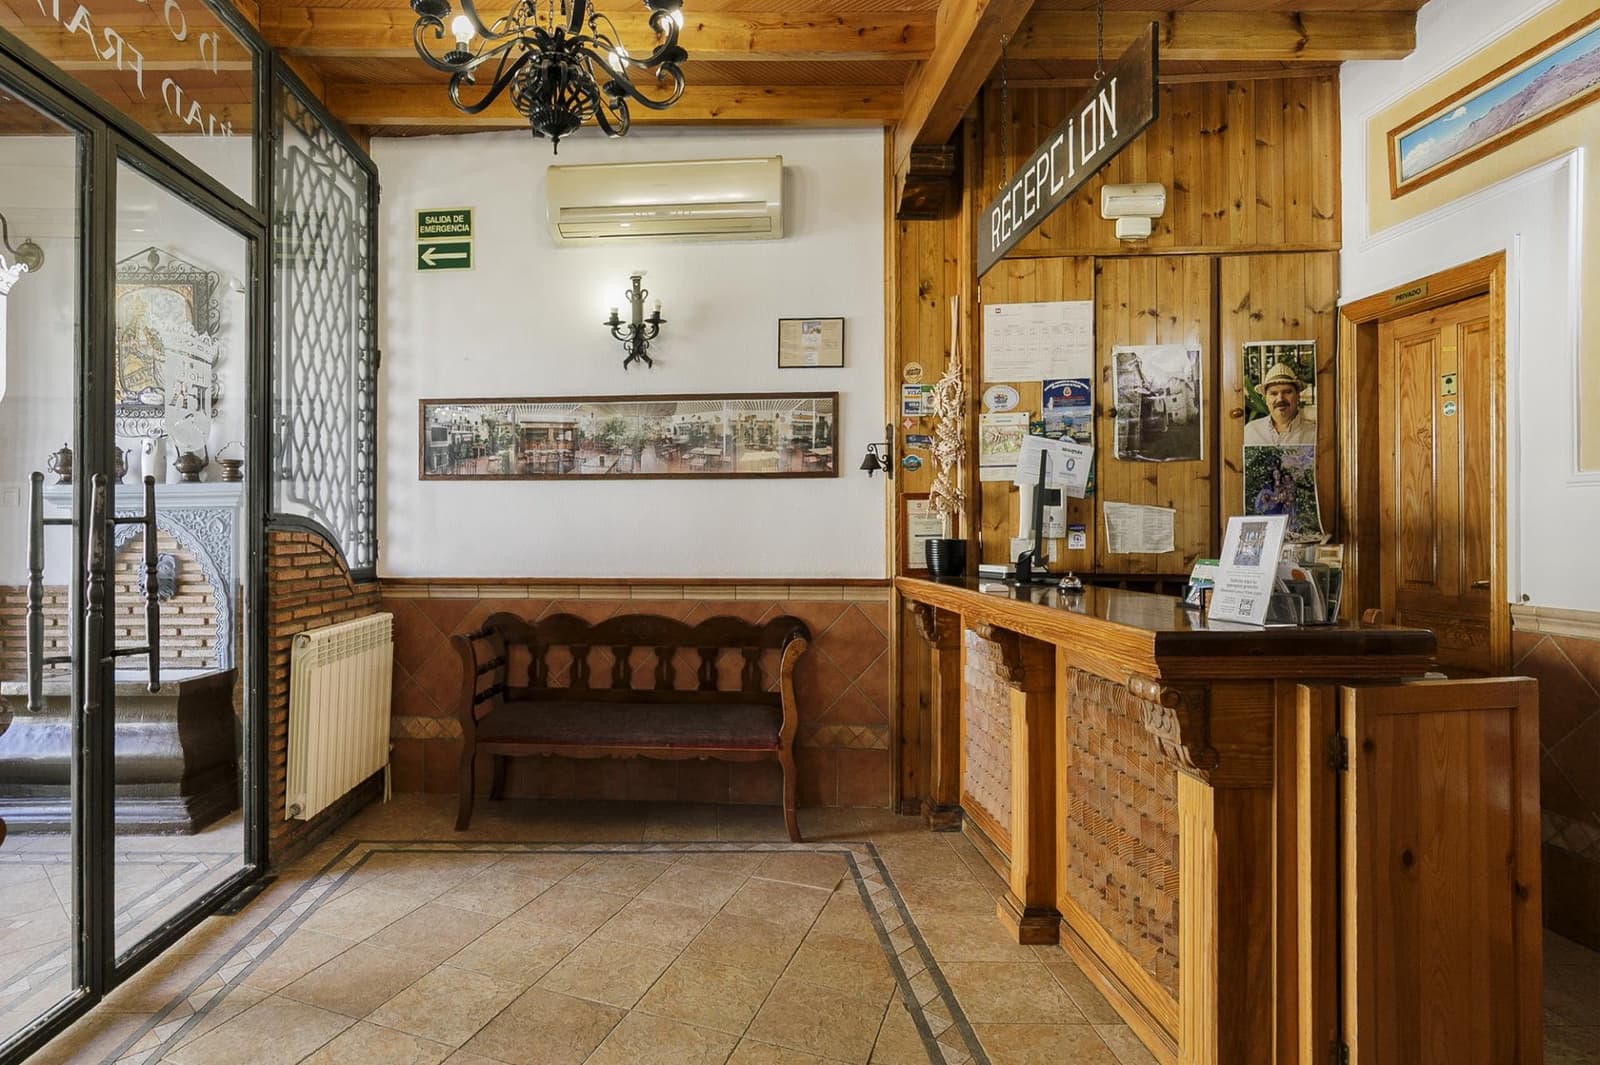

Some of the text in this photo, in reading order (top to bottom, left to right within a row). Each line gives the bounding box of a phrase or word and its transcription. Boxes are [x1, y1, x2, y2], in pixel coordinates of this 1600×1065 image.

[425, 214, 465, 224] SALIDA DE
[420, 224, 470, 233] EMERGENCIA
[1395, 288, 1421, 301] PRIVADO
